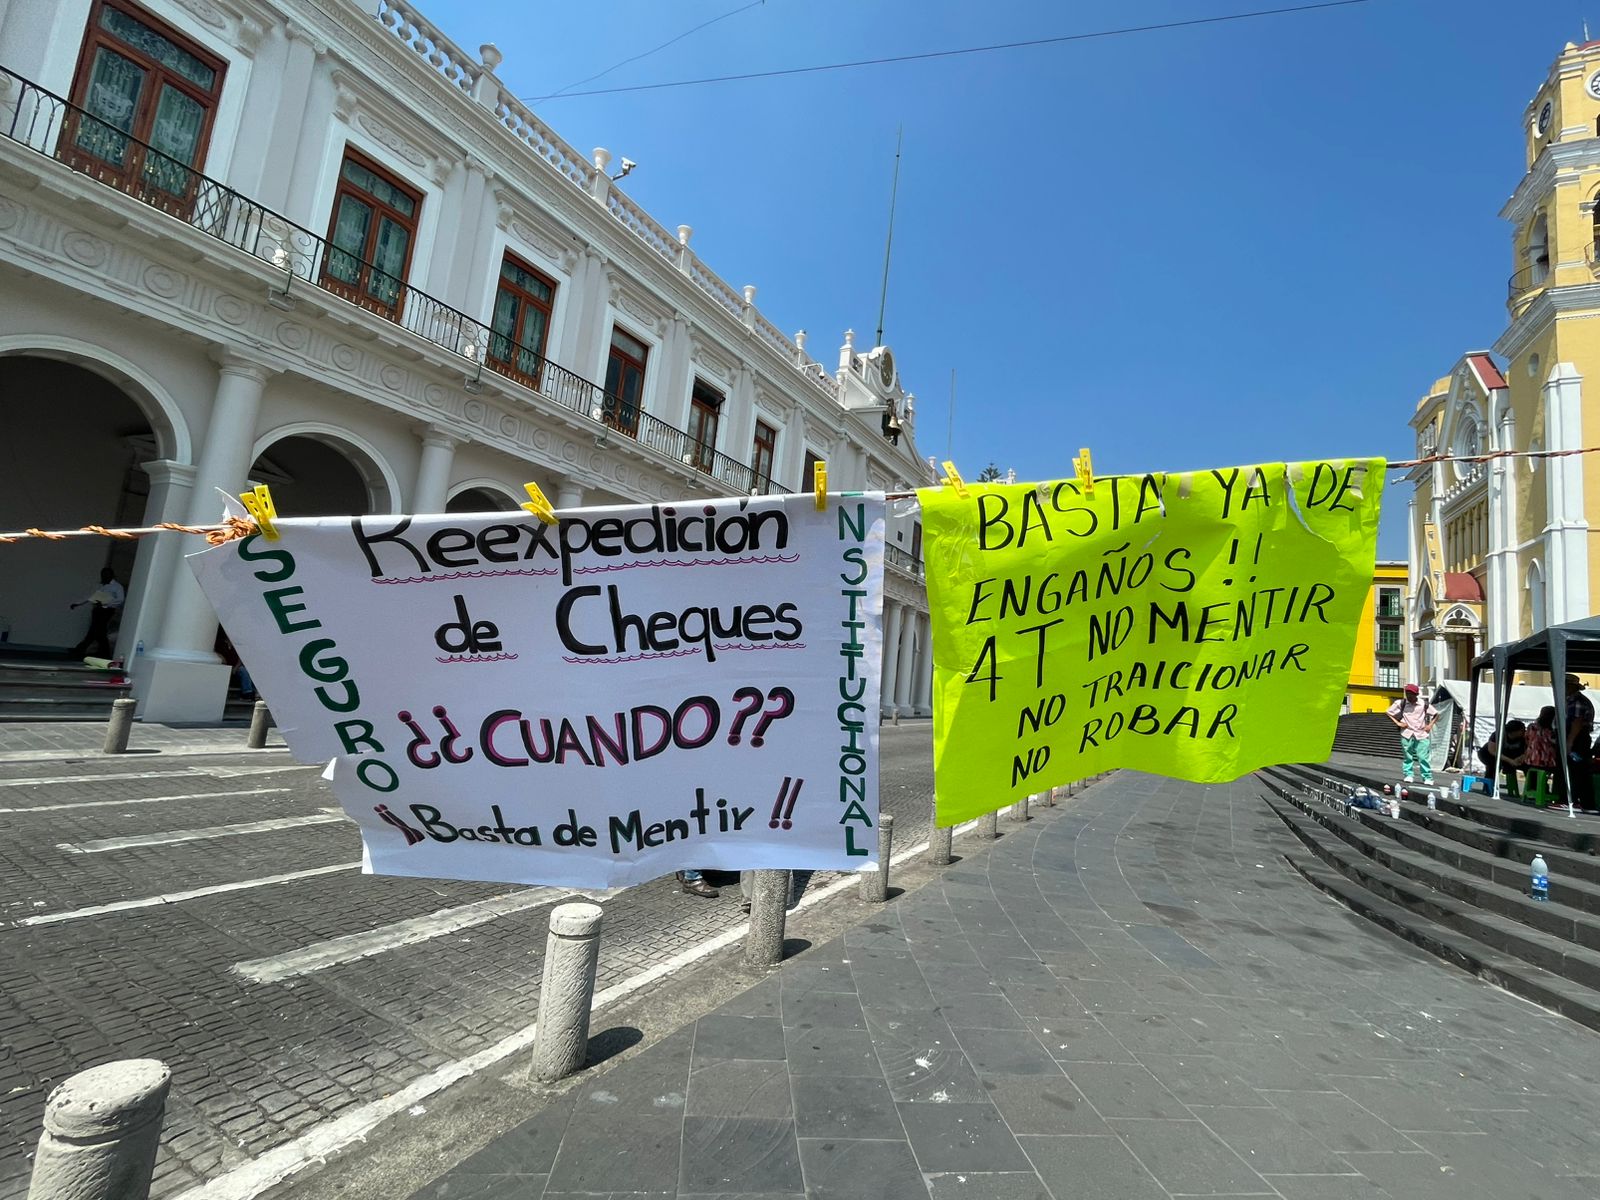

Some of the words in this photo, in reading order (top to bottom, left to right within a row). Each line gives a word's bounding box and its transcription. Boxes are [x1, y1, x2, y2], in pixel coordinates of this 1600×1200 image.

[1210, 467, 1271, 520] YA
[1305, 462, 1369, 513] DE
[434, 594, 503, 655] de
[555, 583, 803, 663] Cheques
[965, 541, 1196, 626] ENGAÑOS
[1087, 605, 1135, 662] NO
[1147, 582, 1336, 645] MENTIR
[237, 534, 400, 793] SEGURO
[837, 491, 872, 856] NSTITUCIONAL
[1017, 693, 1067, 740] NO
[1082, 643, 1310, 709] TRAICIONAR
[1011, 745, 1051, 789] NO
[1078, 703, 1238, 754] ROBAR
[552, 808, 598, 848] de
[608, 787, 755, 854] Mentir
